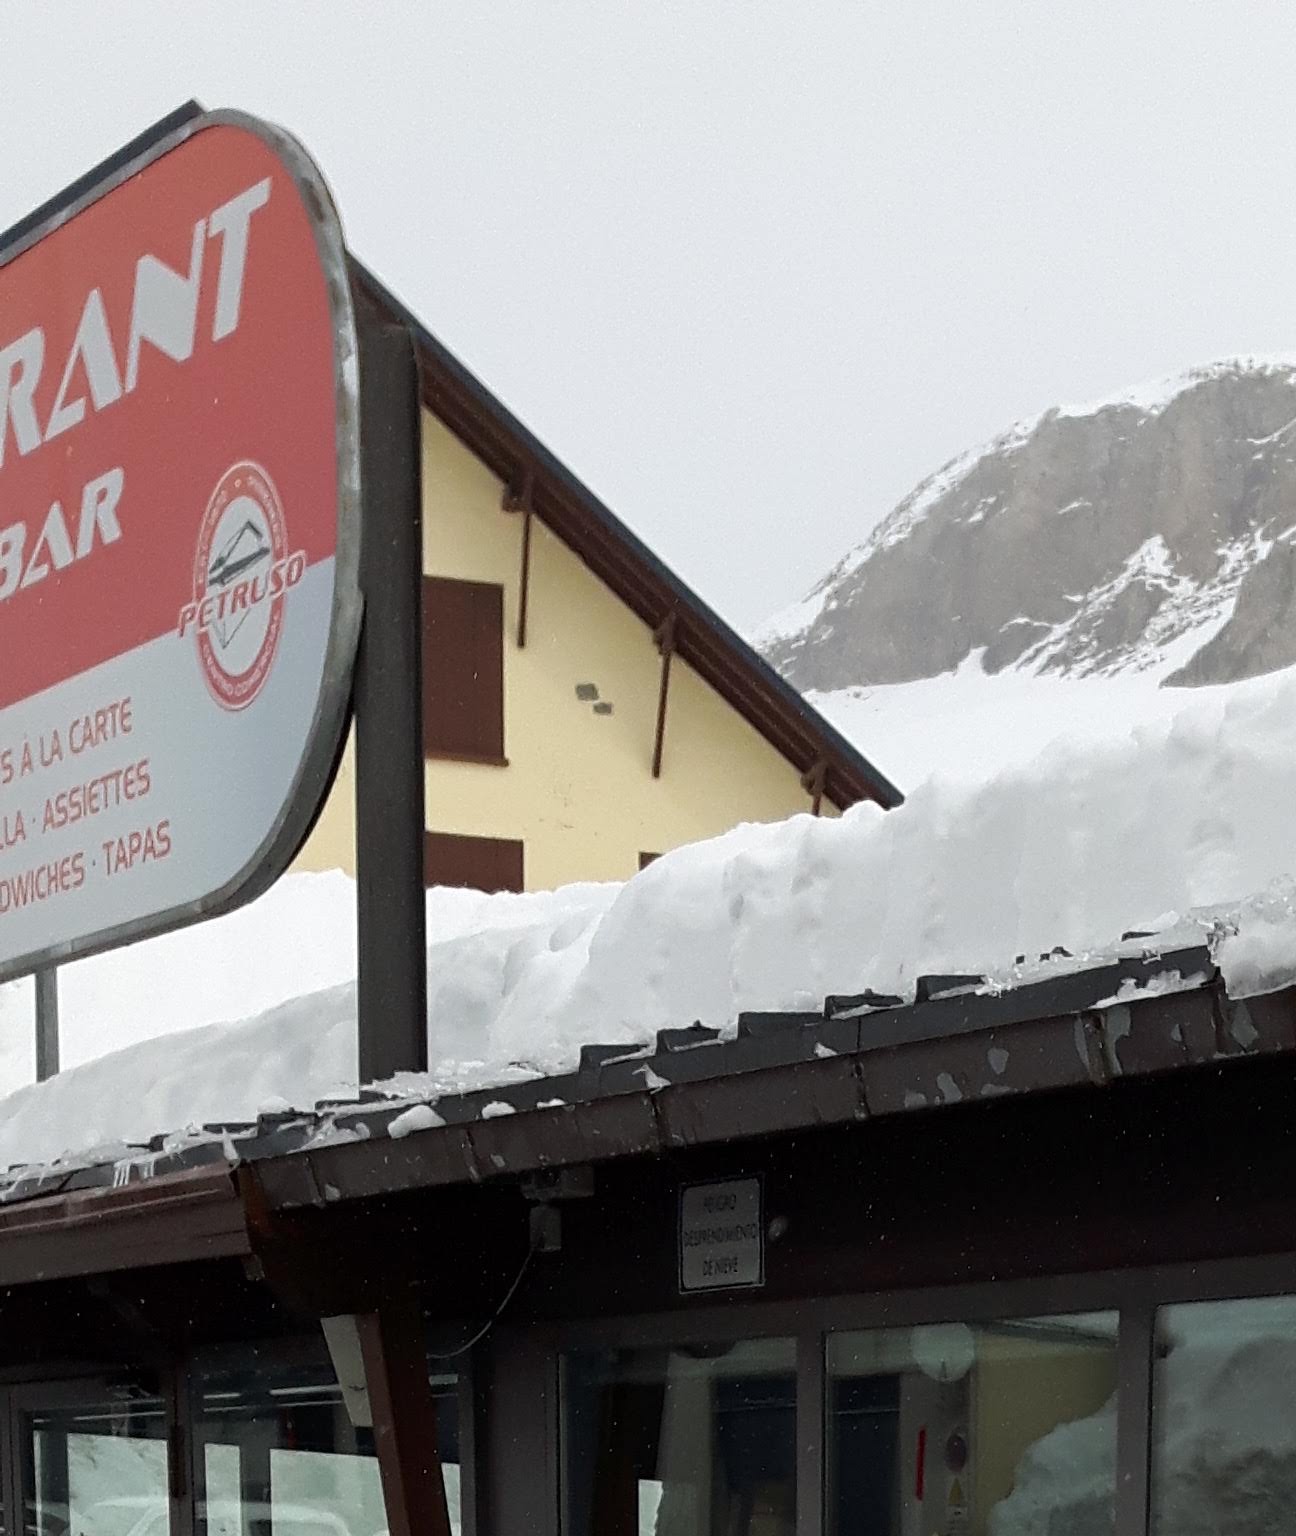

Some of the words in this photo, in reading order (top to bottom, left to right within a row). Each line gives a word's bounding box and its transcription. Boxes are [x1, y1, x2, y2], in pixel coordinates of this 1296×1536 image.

[178, 549, 307, 638] PETRUSO
[40, 729, 63, 768] LA
[69, 696, 133, 754] CARTE
[43, 757, 150, 834] ASSIETTES
[102, 818, 171, 876] TAPAS
